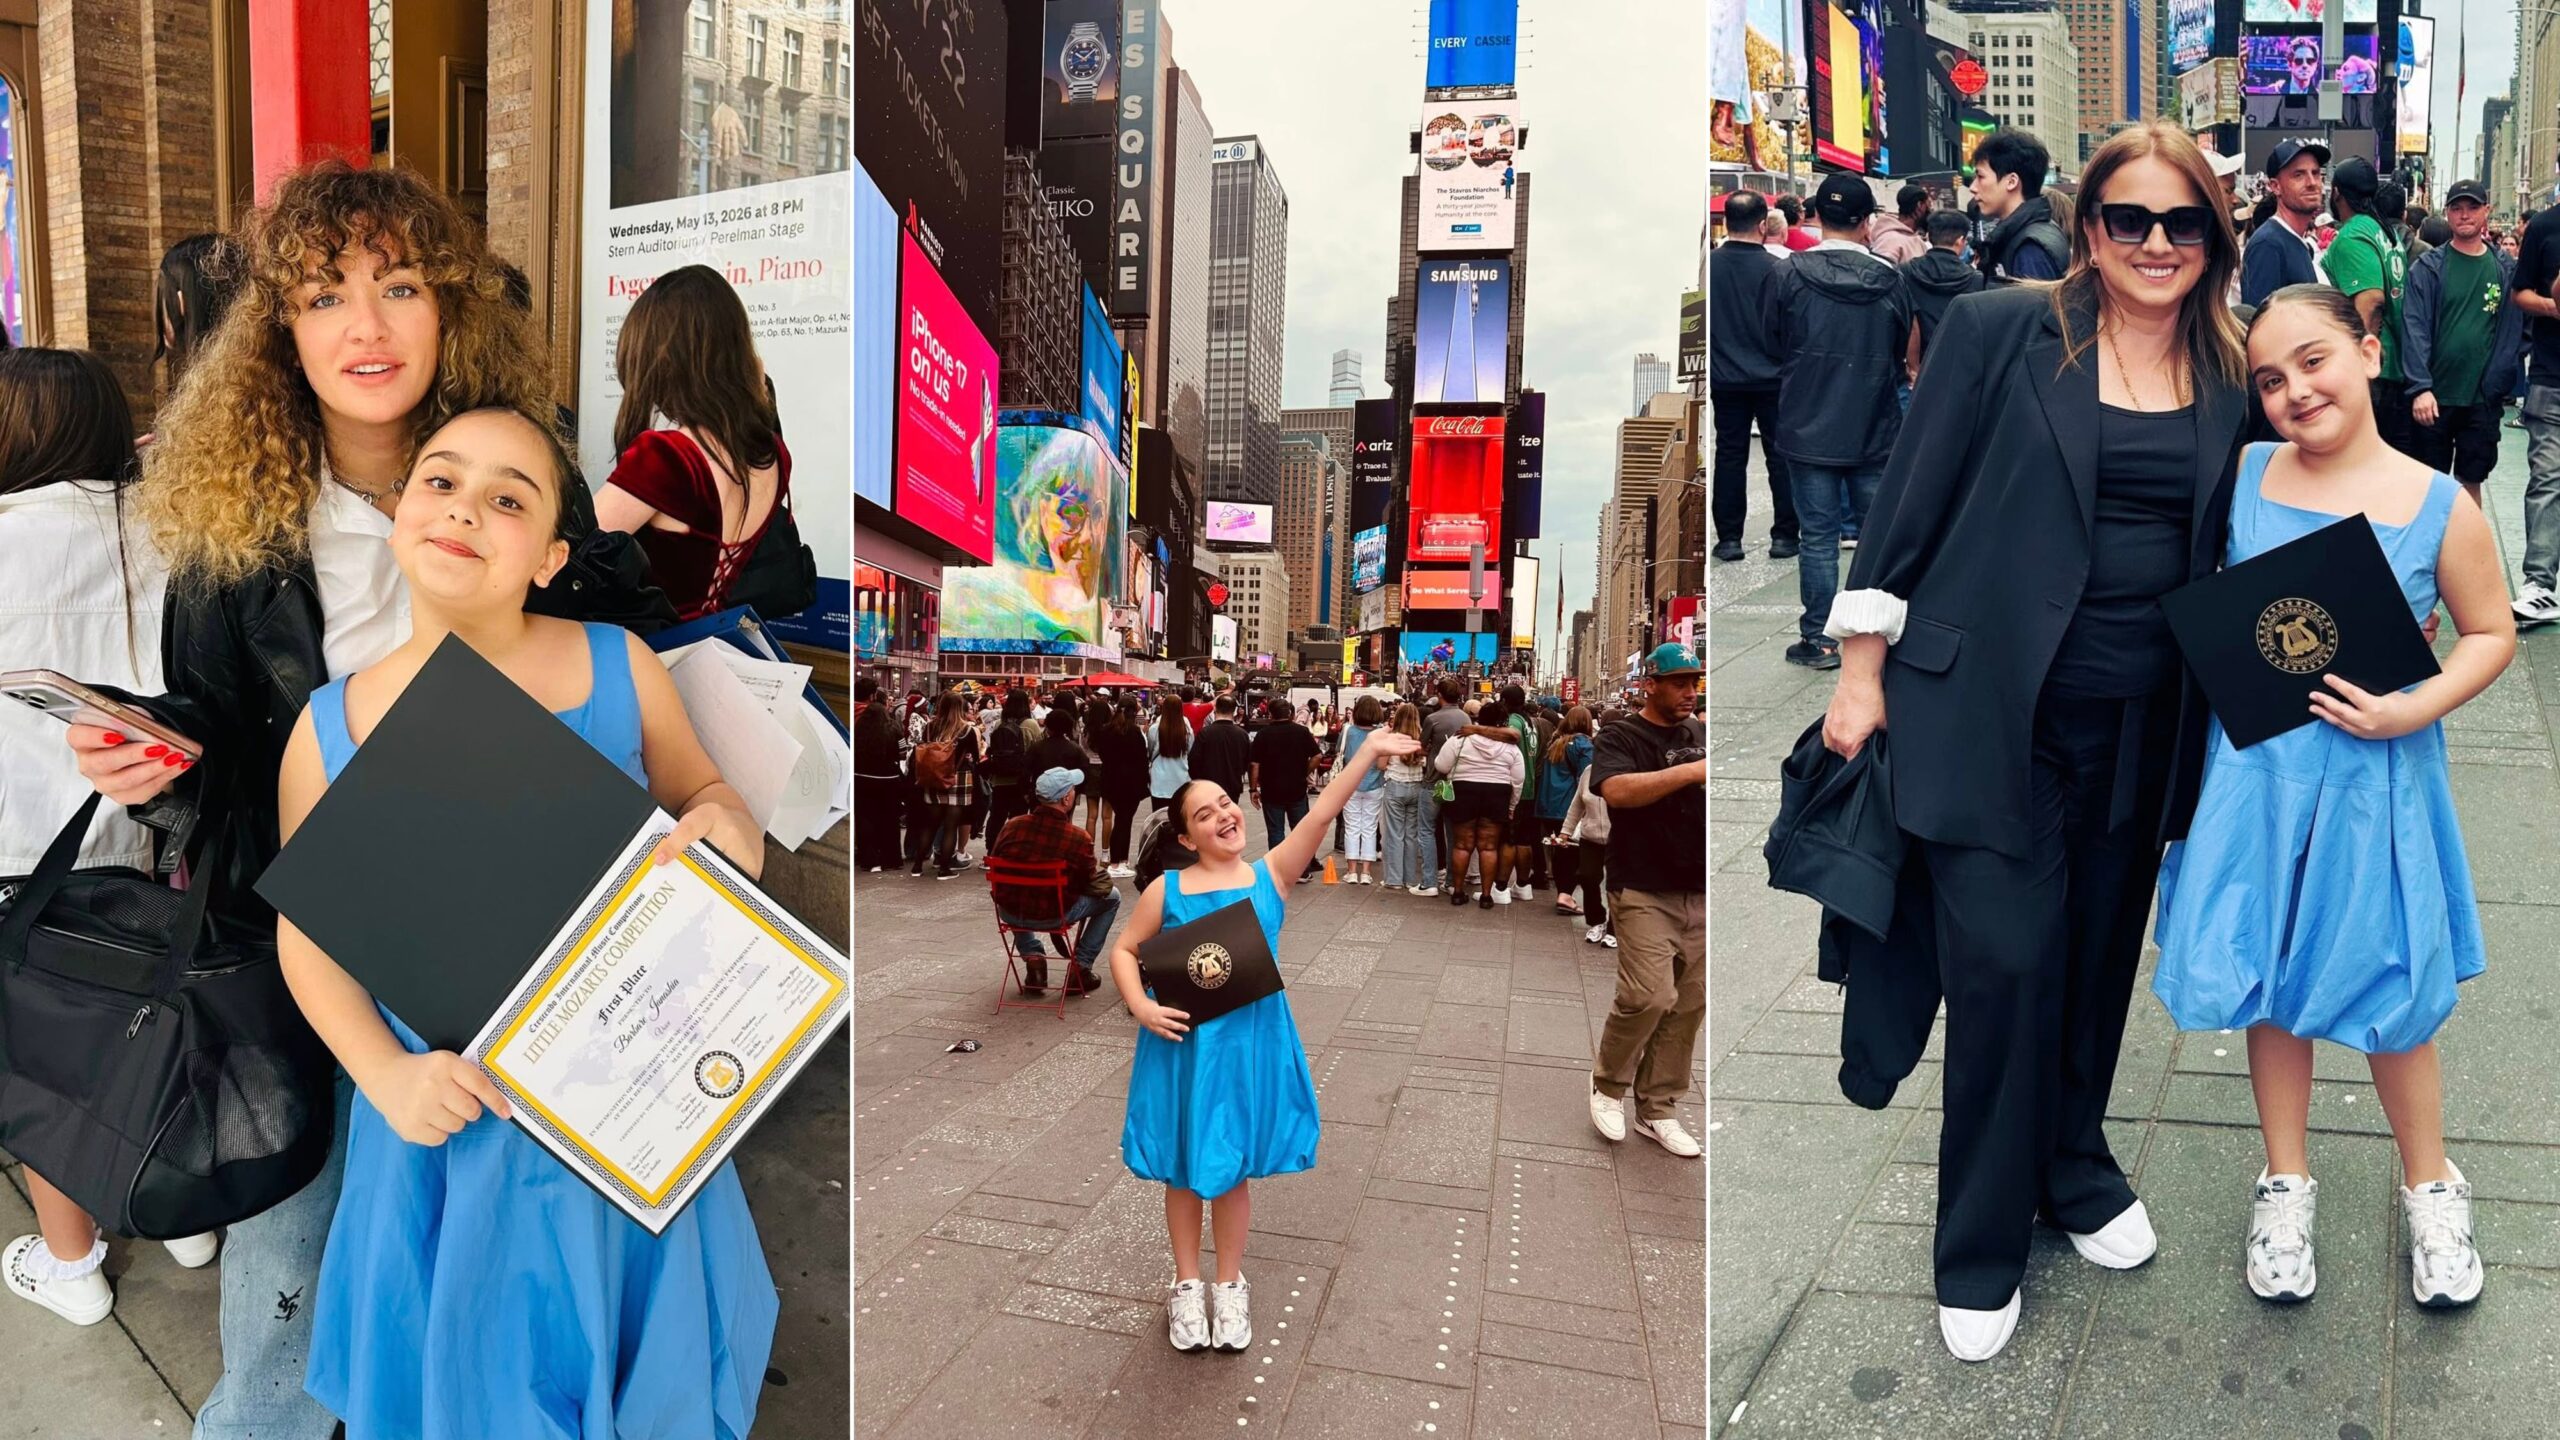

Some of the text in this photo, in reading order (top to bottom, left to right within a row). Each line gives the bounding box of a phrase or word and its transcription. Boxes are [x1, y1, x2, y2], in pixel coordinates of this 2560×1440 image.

[1434, 35, 1512, 48] EVERY CASSIE
[861, 0, 891, 60] GET
[893, 47, 944, 159] TICKETS
[947, 143, 968, 200] NOW
[1212, 147, 1227, 160] nz
[1047, 186, 1075, 195] Classic
[1117, 94, 1144, 290] SQUARE
[1047, 199, 1094, 217] EIKO
[609, 198, 804, 239] Wednesday, May 13, 2026 at 8 PM
[608, 241, 635, 258] Stern
[637, 235, 699, 254] Auditorium
[710, 229, 766, 245] Perelman
[769, 222, 805, 240] Stage
[608, 275, 657, 301] Evge
[760, 255, 822, 282] Piano
[1431, 269, 1498, 282] SAMSUNG
[771, 303, 776, 311] 3
[768, 317, 787, 325] A-flat
[789, 316, 812, 325] Major,
[813, 314, 826, 323] Op.
[767, 329, 779, 337] Op.
[781, 328, 792, 336] 63,
[794, 327, 807, 335] No.
[815, 325, 847, 334] Mazurka
[912, 304, 954, 377] iPhone
[956, 359, 968, 389] 17
[911, 347, 950, 403] on us
[910, 378, 920, 398] No
[921, 390, 946, 422] trade-in
[945, 415, 966, 441] needed
[1369, 438, 1393, 451] ariz
[1363, 462, 1381, 470] Trace
[822, 615, 849, 623] AIRLINES
[1355, 674, 1363, 687] tkt
[1566, 680, 1576, 700] tkts
[522, 878, 678, 1065] LITTLE MOZARTS COMPETITION
[526, 890, 646, 1034] Crescendo International Music Competitions
[593, 961, 650, 1026] First Place
